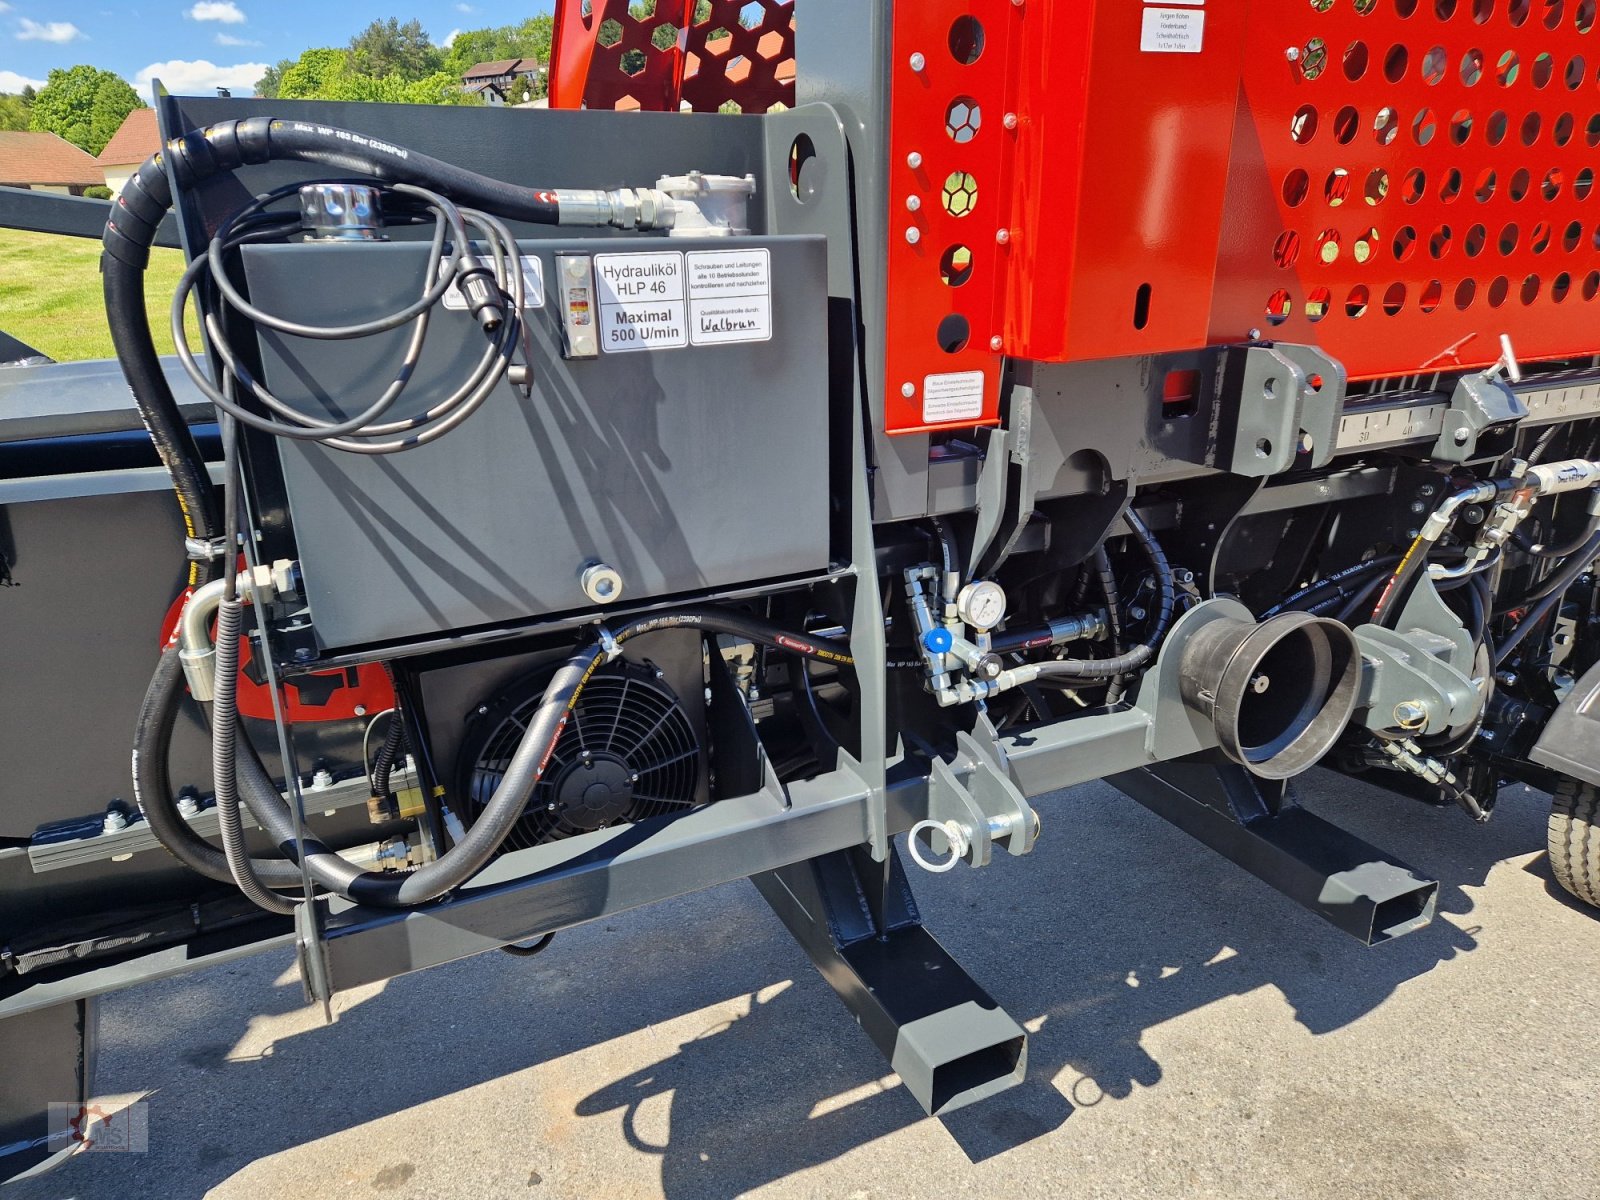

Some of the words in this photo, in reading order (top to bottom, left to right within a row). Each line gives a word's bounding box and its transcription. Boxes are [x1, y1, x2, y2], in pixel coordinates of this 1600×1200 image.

[352, 134, 369, 146] Bar
[603, 263, 677, 281] Hydrauliköl
[617, 282, 646, 295] HLP
[650, 280, 666, 294] 46
[616, 309, 672, 325] Maximal
[700, 308, 744, 316] Qualitätskontrolle
[700, 317, 756, 332] Walbrun
[611, 328, 636, 342] 500
[640, 326, 679, 340] U/min
[1359, 431, 1370, 443] 30
